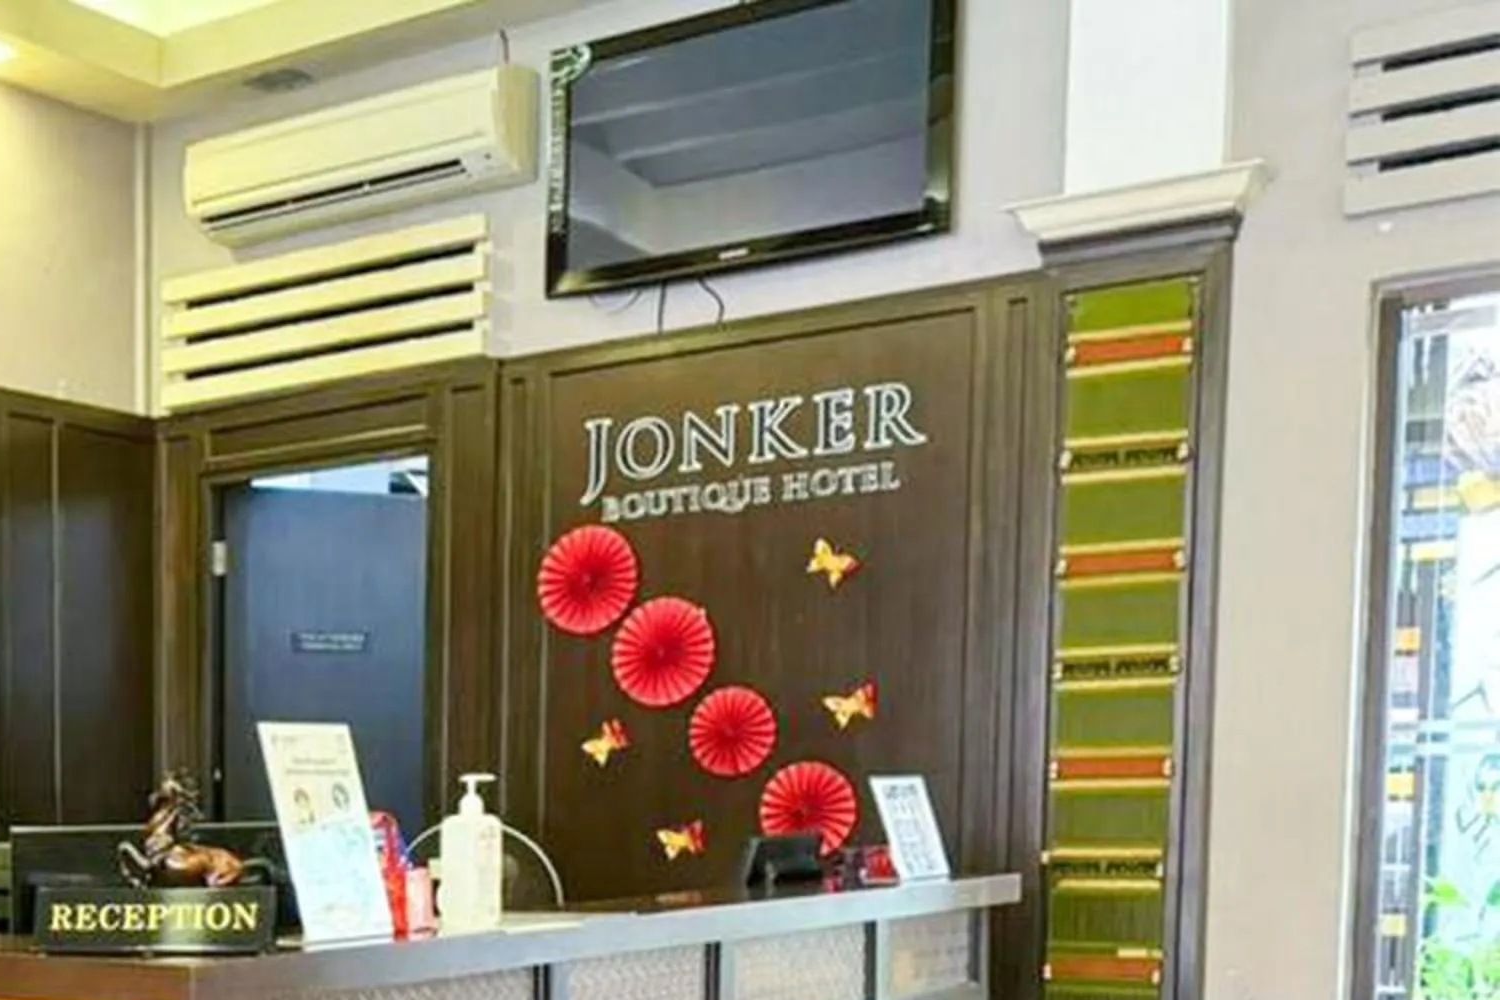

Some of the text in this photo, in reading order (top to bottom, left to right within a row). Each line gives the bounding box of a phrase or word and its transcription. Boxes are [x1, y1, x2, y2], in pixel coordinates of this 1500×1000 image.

[580, 382, 928, 506] JONKER
[602, 460, 901, 523] BOUTIQUE HOTEL
[49, 902, 259, 932] RECEPTION
